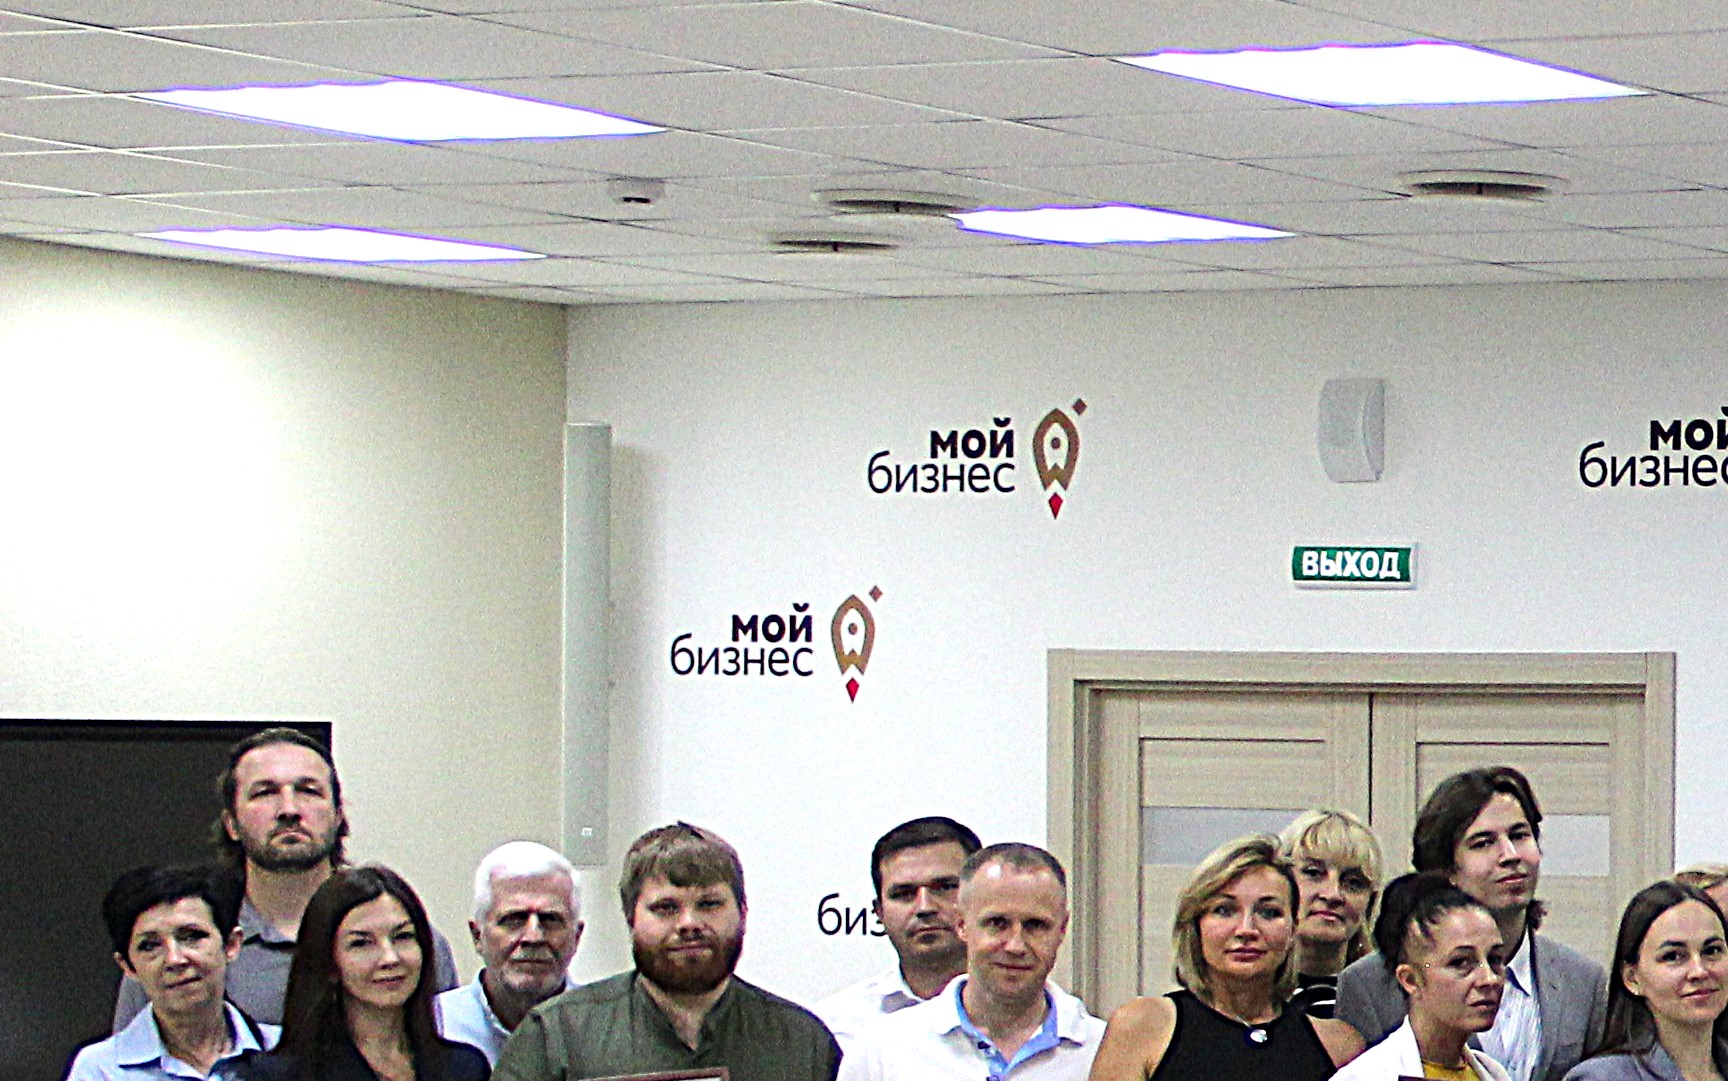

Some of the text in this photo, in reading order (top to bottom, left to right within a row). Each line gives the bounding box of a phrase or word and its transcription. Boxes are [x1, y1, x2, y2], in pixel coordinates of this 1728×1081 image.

[931, 418, 1014, 458] мой
[868, 450, 1015, 494] бизнес
[1302, 550, 1401, 580] ВЫХОД
[731, 603, 813, 643] мой
[670, 634, 813, 677] бизнес
